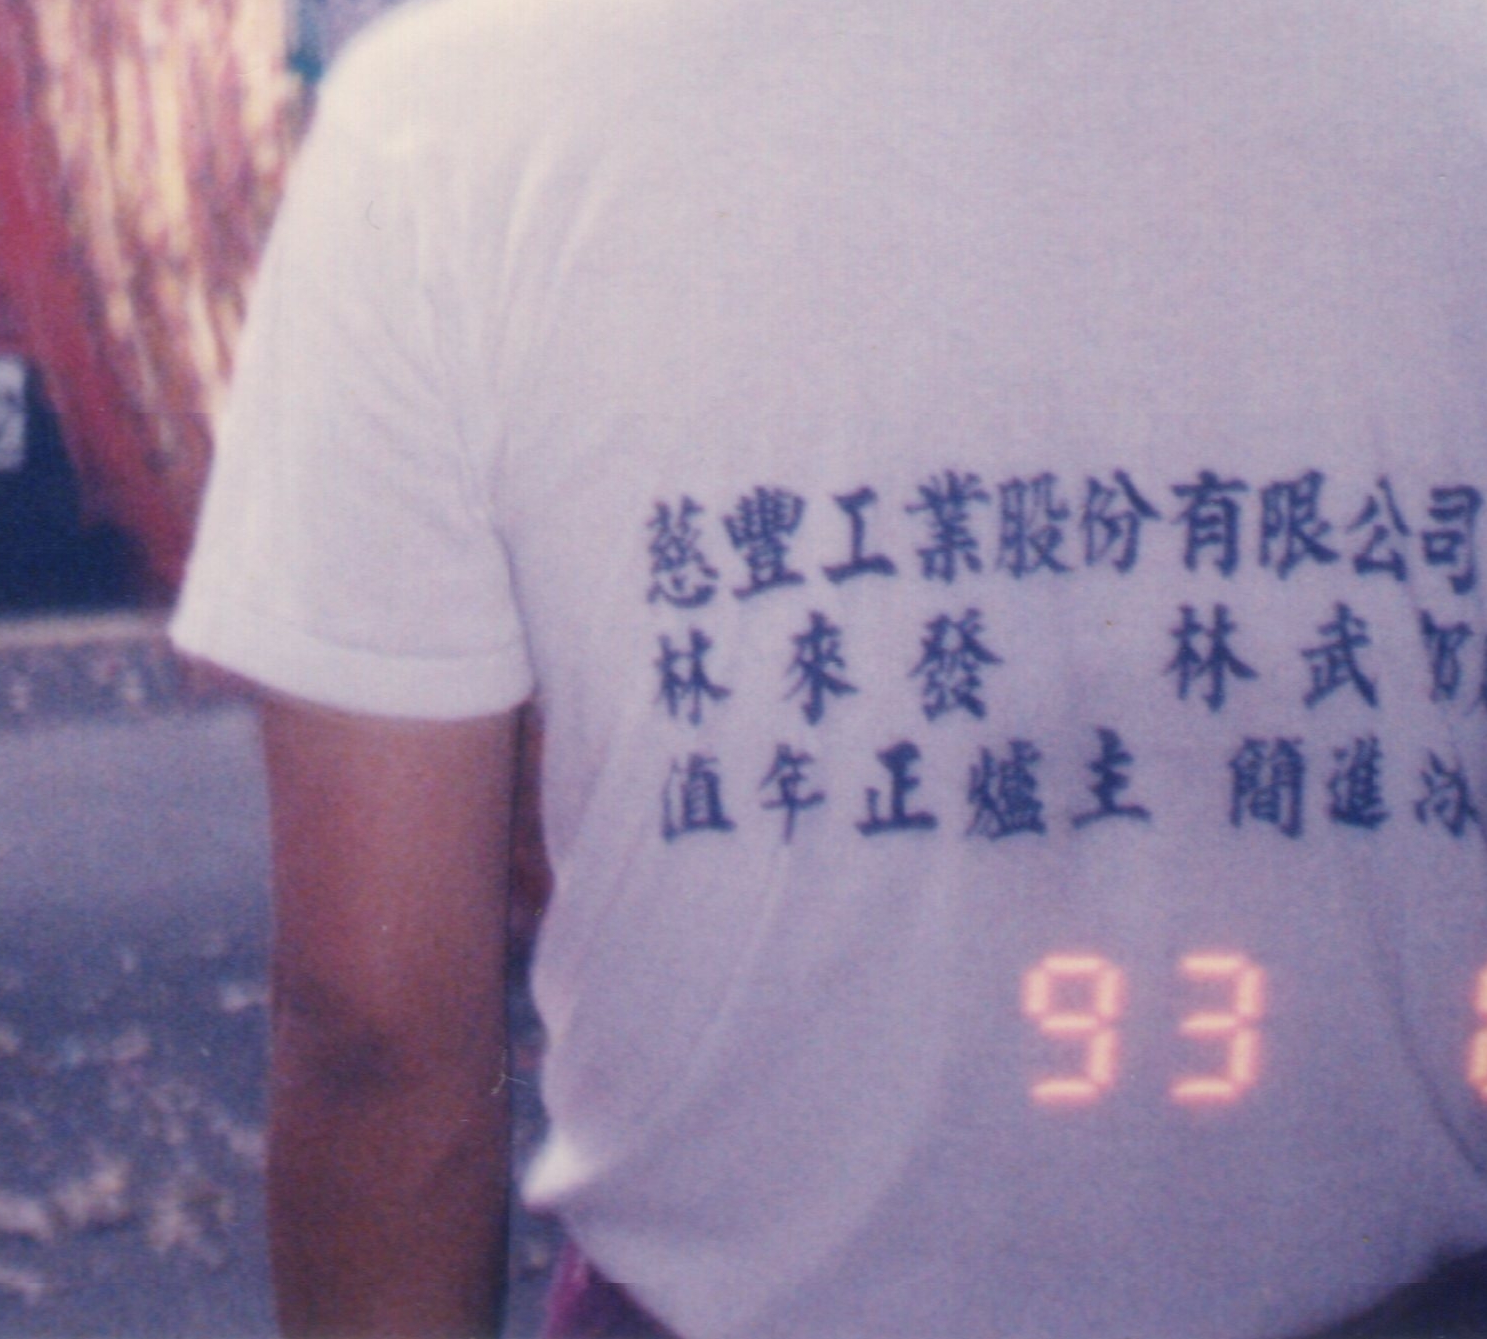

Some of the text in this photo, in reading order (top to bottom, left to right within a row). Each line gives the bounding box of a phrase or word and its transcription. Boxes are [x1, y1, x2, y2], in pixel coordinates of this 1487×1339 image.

[641, 468, 1487, 610] 慈豐工業股份有限公司
[651, 606, 1005, 726] 林來發
